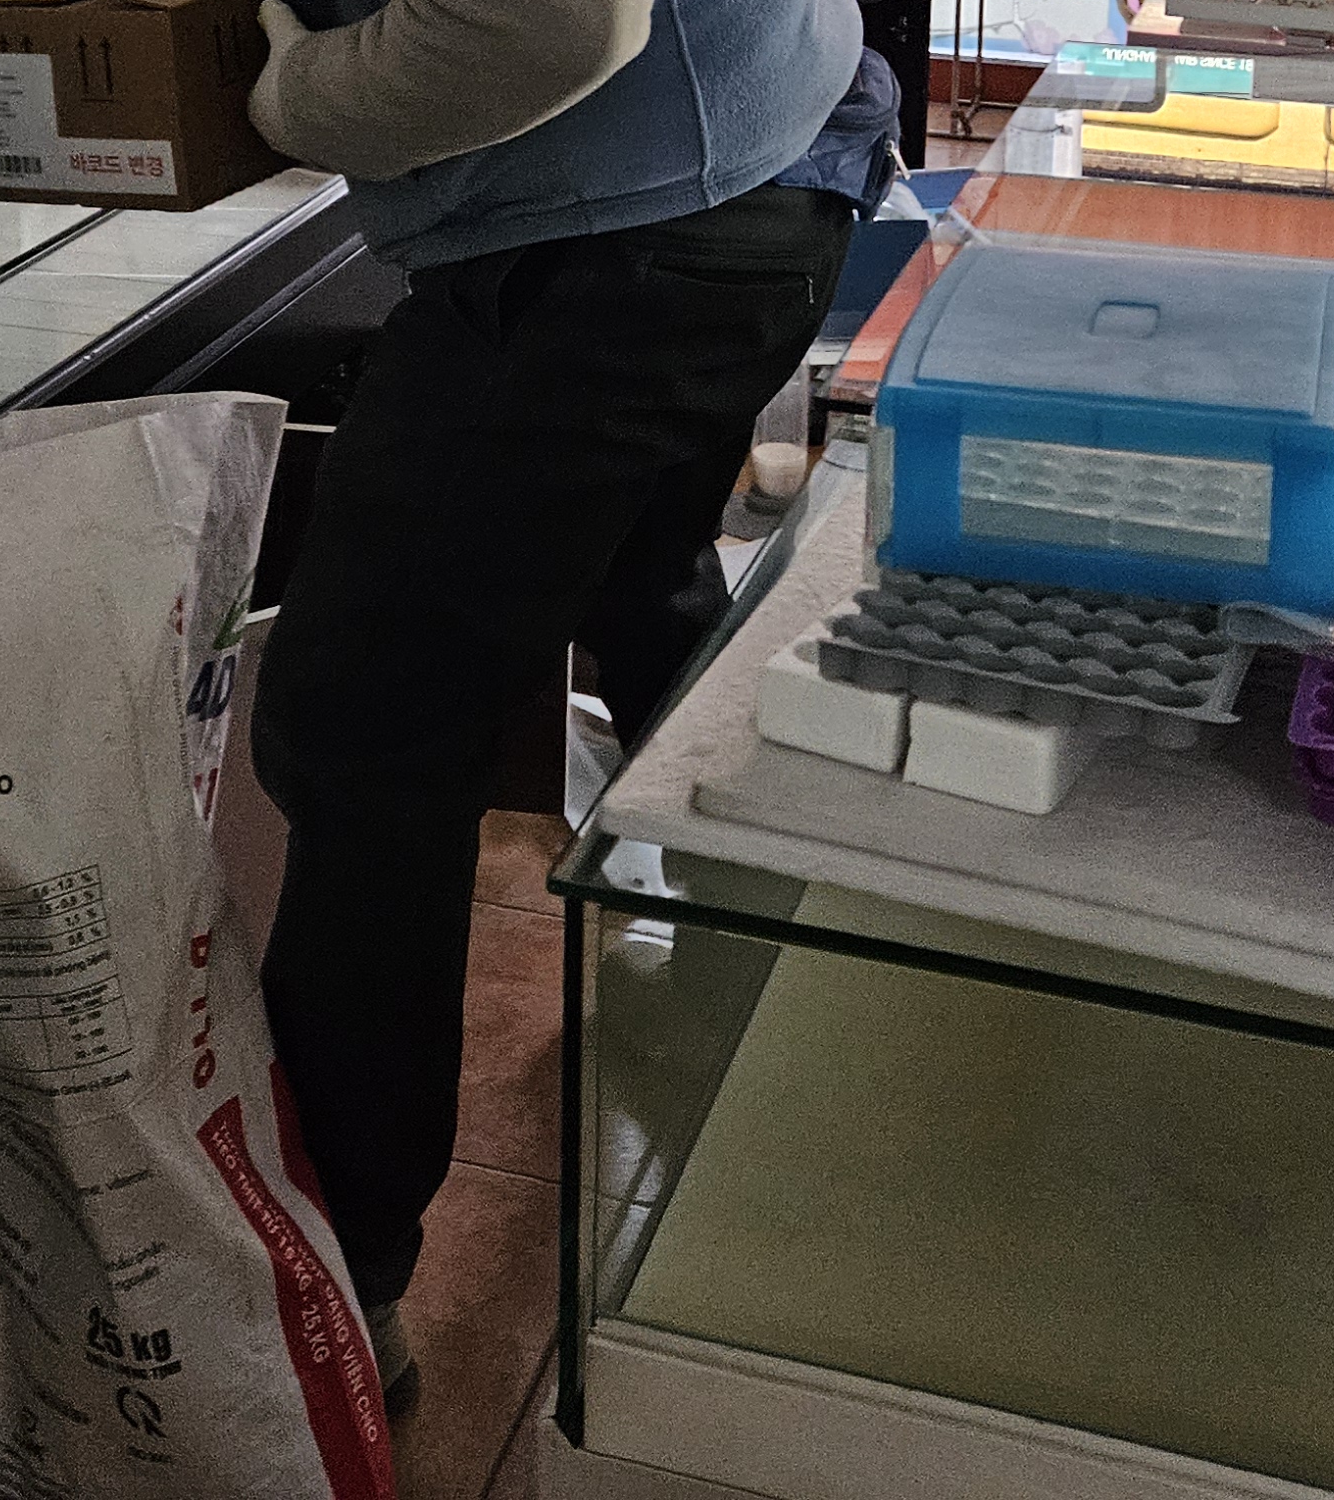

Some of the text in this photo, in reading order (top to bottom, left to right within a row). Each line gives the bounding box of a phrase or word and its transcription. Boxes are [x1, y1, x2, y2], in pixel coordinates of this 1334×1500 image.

[87, 1304, 173, 1362] 25 kg
[292, 1261, 314, 1293] KG
[307, 1332, 331, 1364] KG
